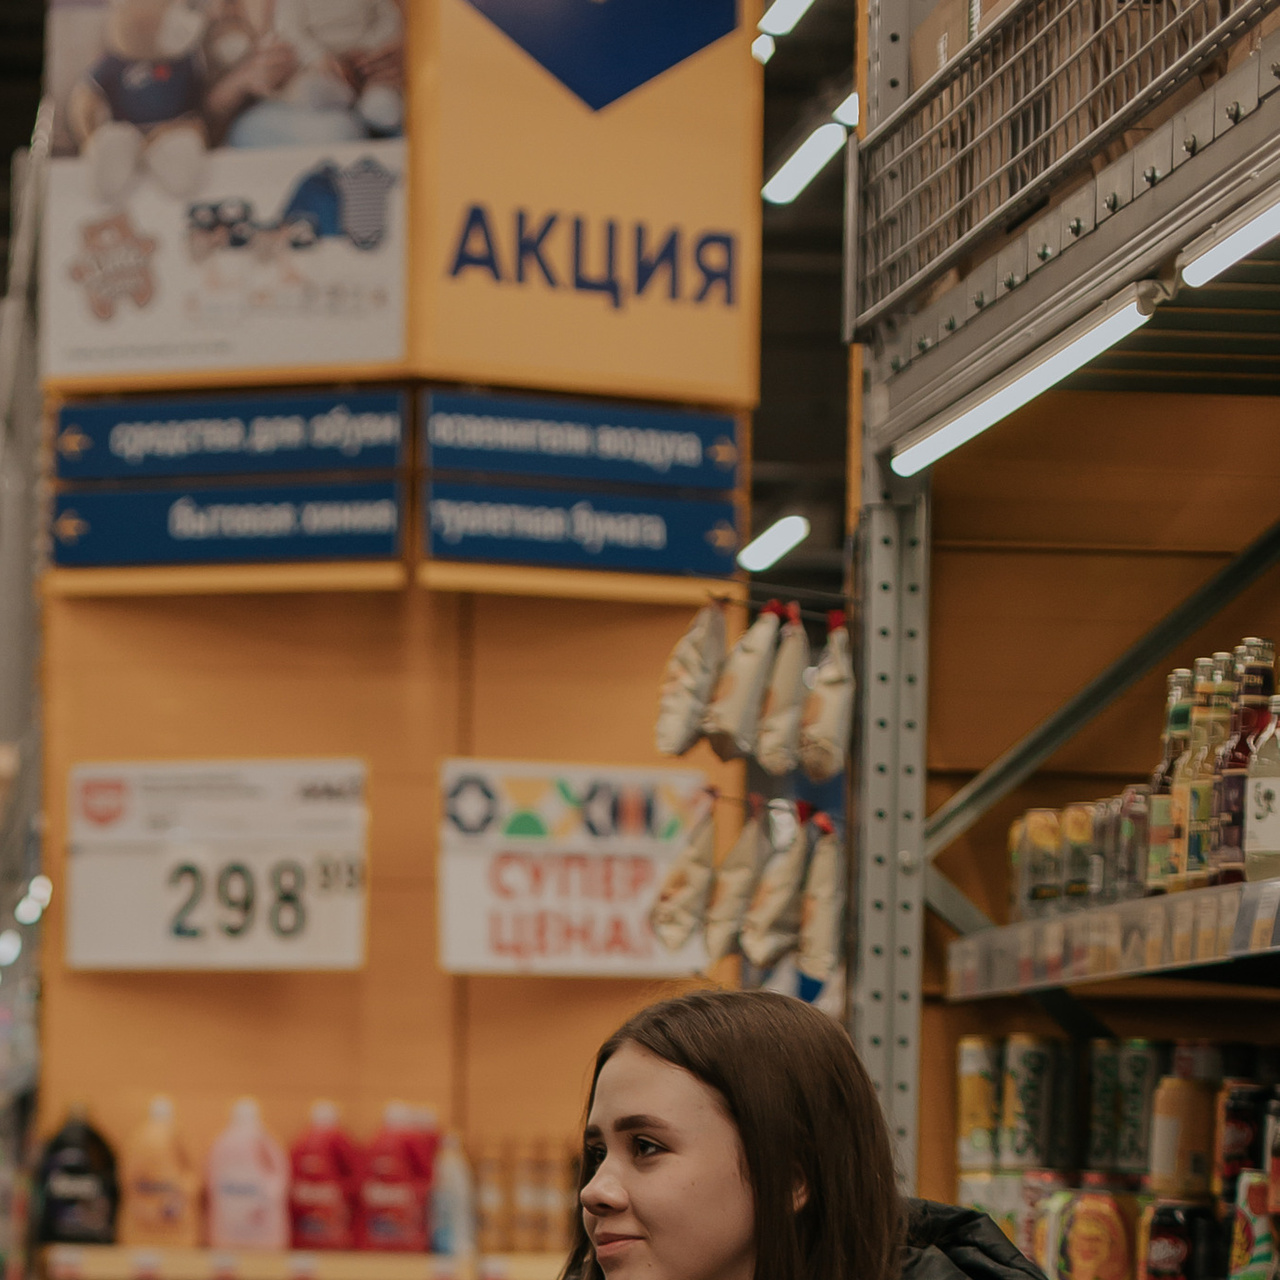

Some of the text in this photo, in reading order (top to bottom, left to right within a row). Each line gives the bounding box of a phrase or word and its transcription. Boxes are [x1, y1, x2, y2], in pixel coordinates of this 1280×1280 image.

[447, 202, 736, 308] АКЦИЯ
[168, 860, 308, 940] 298
[489, 852, 654, 899] СУПЕР
